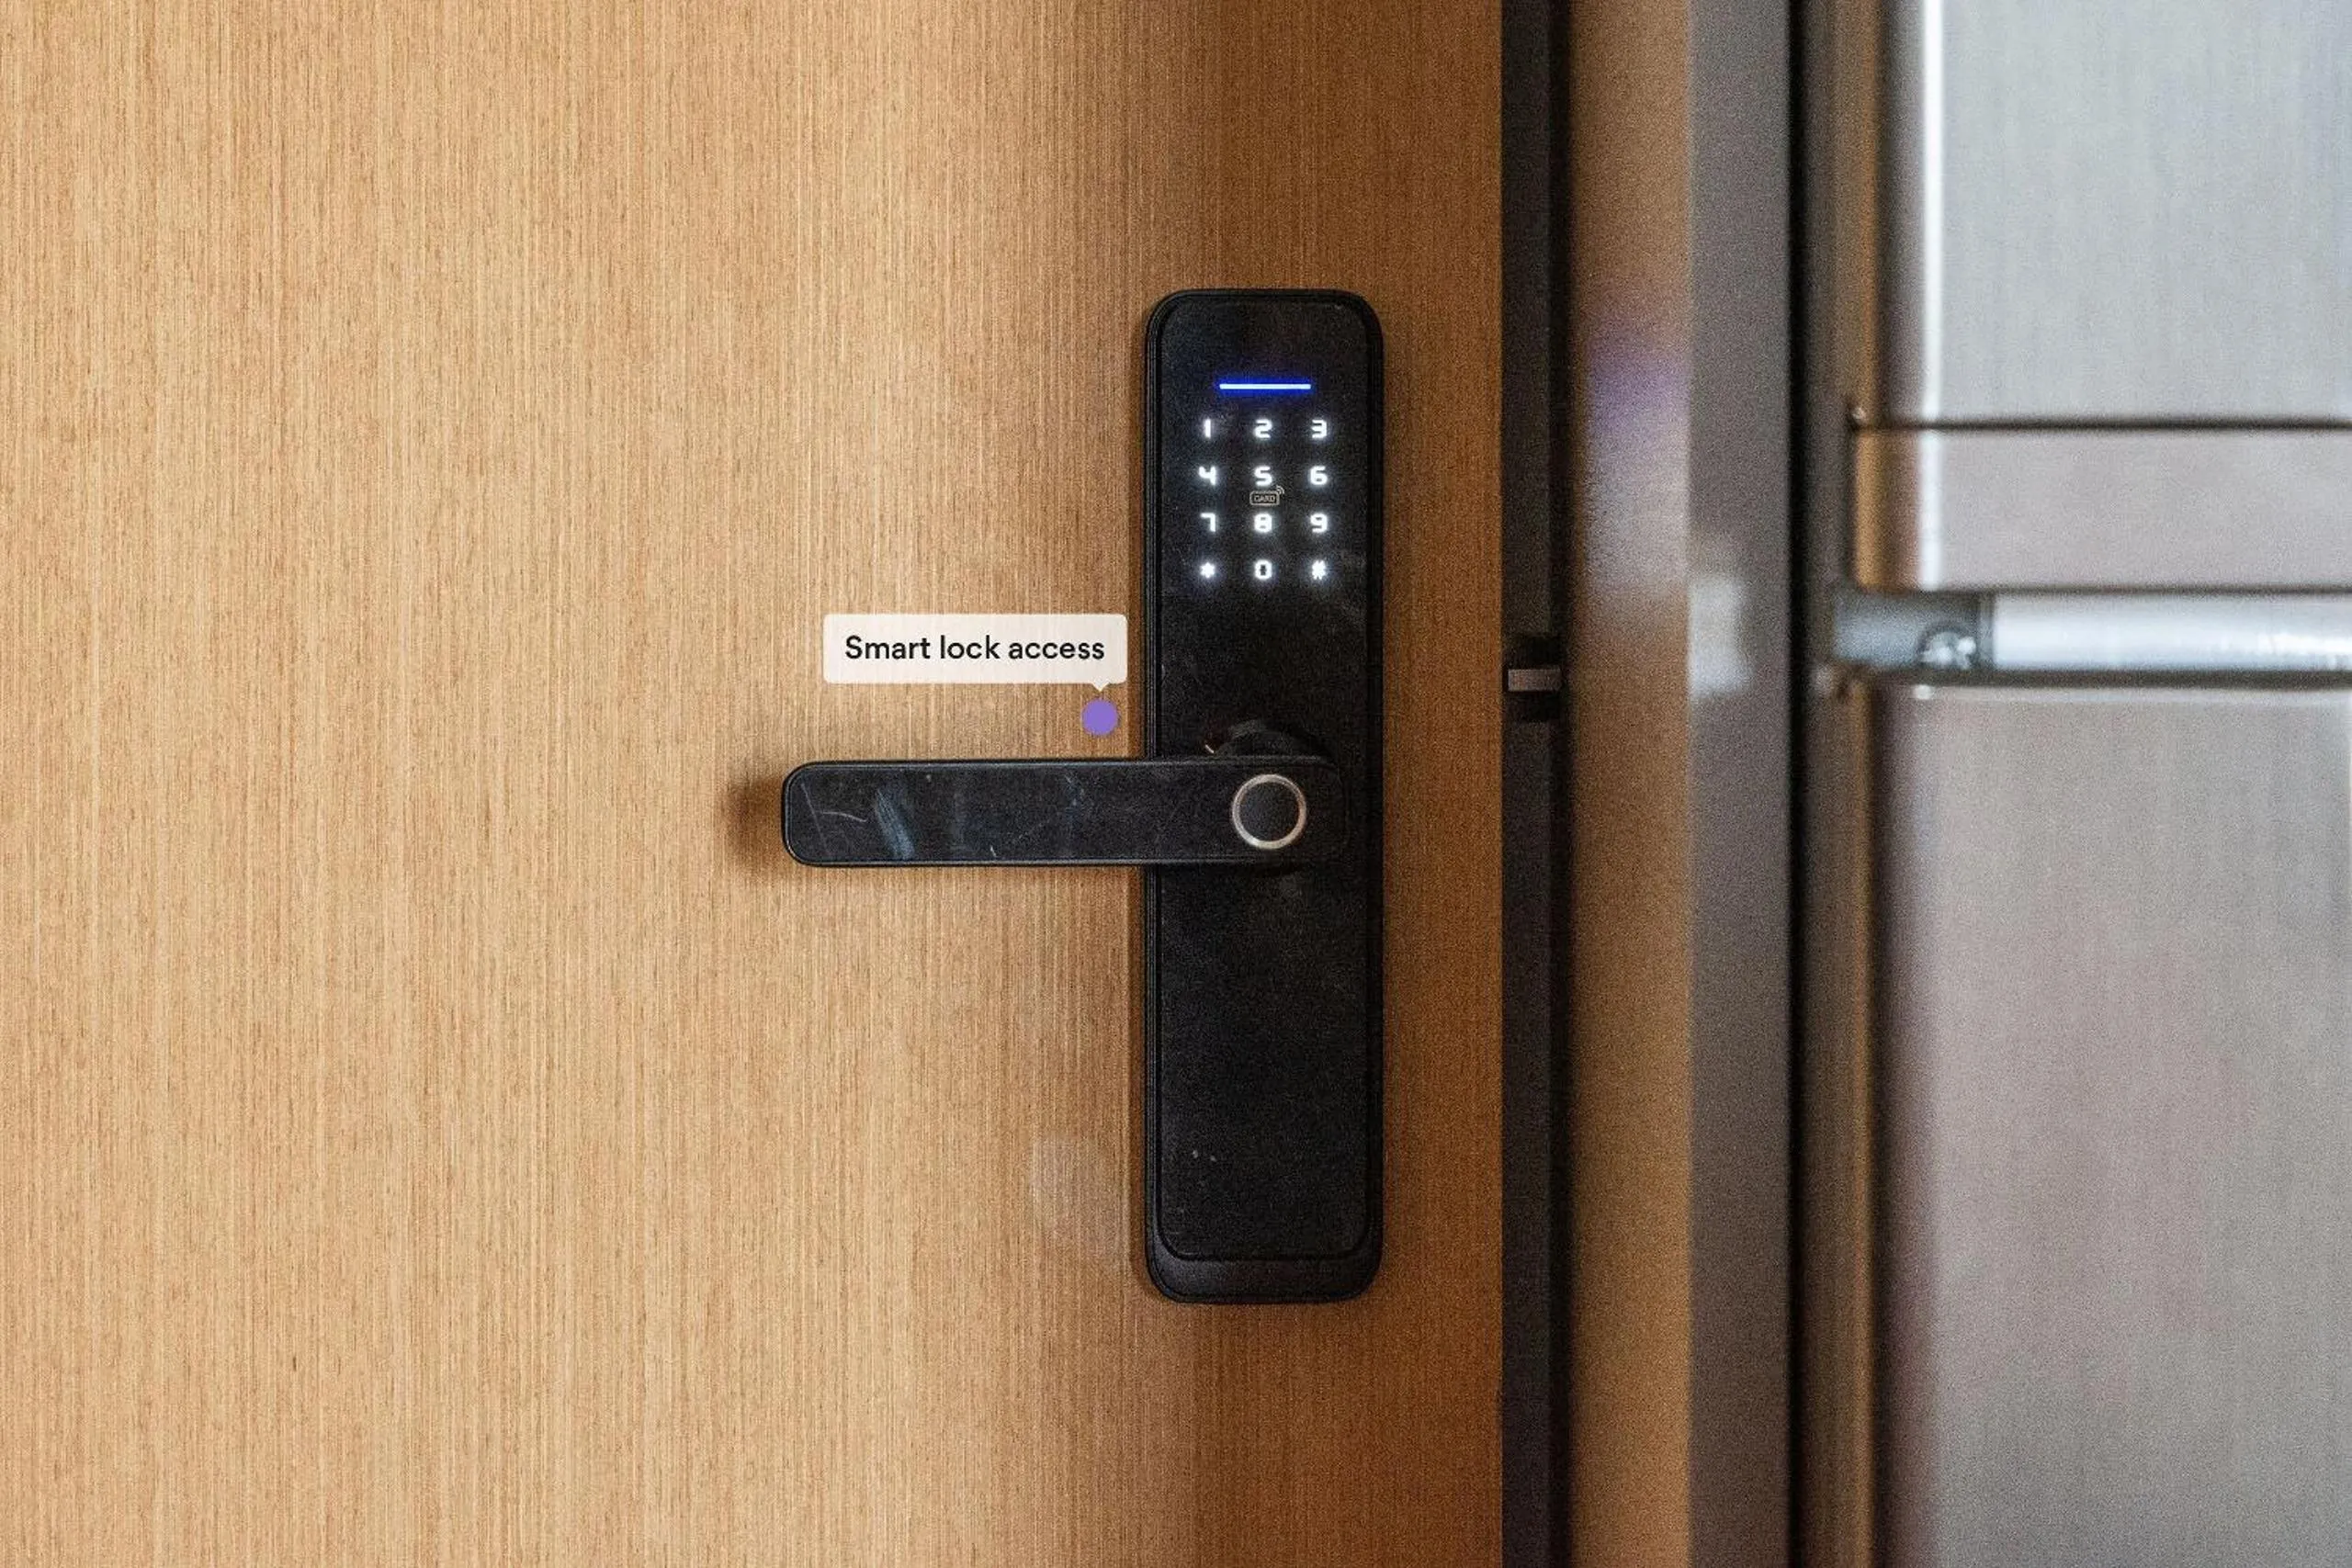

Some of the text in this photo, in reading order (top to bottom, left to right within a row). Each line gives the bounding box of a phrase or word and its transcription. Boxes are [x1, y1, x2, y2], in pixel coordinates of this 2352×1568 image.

[1203, 418, 1328, 439] 1 2 3
[1198, 466, 1329, 487] 4 5 6
[1200, 513, 1329, 534] 7 8 9
[1253, 559, 1273, 581] 0
